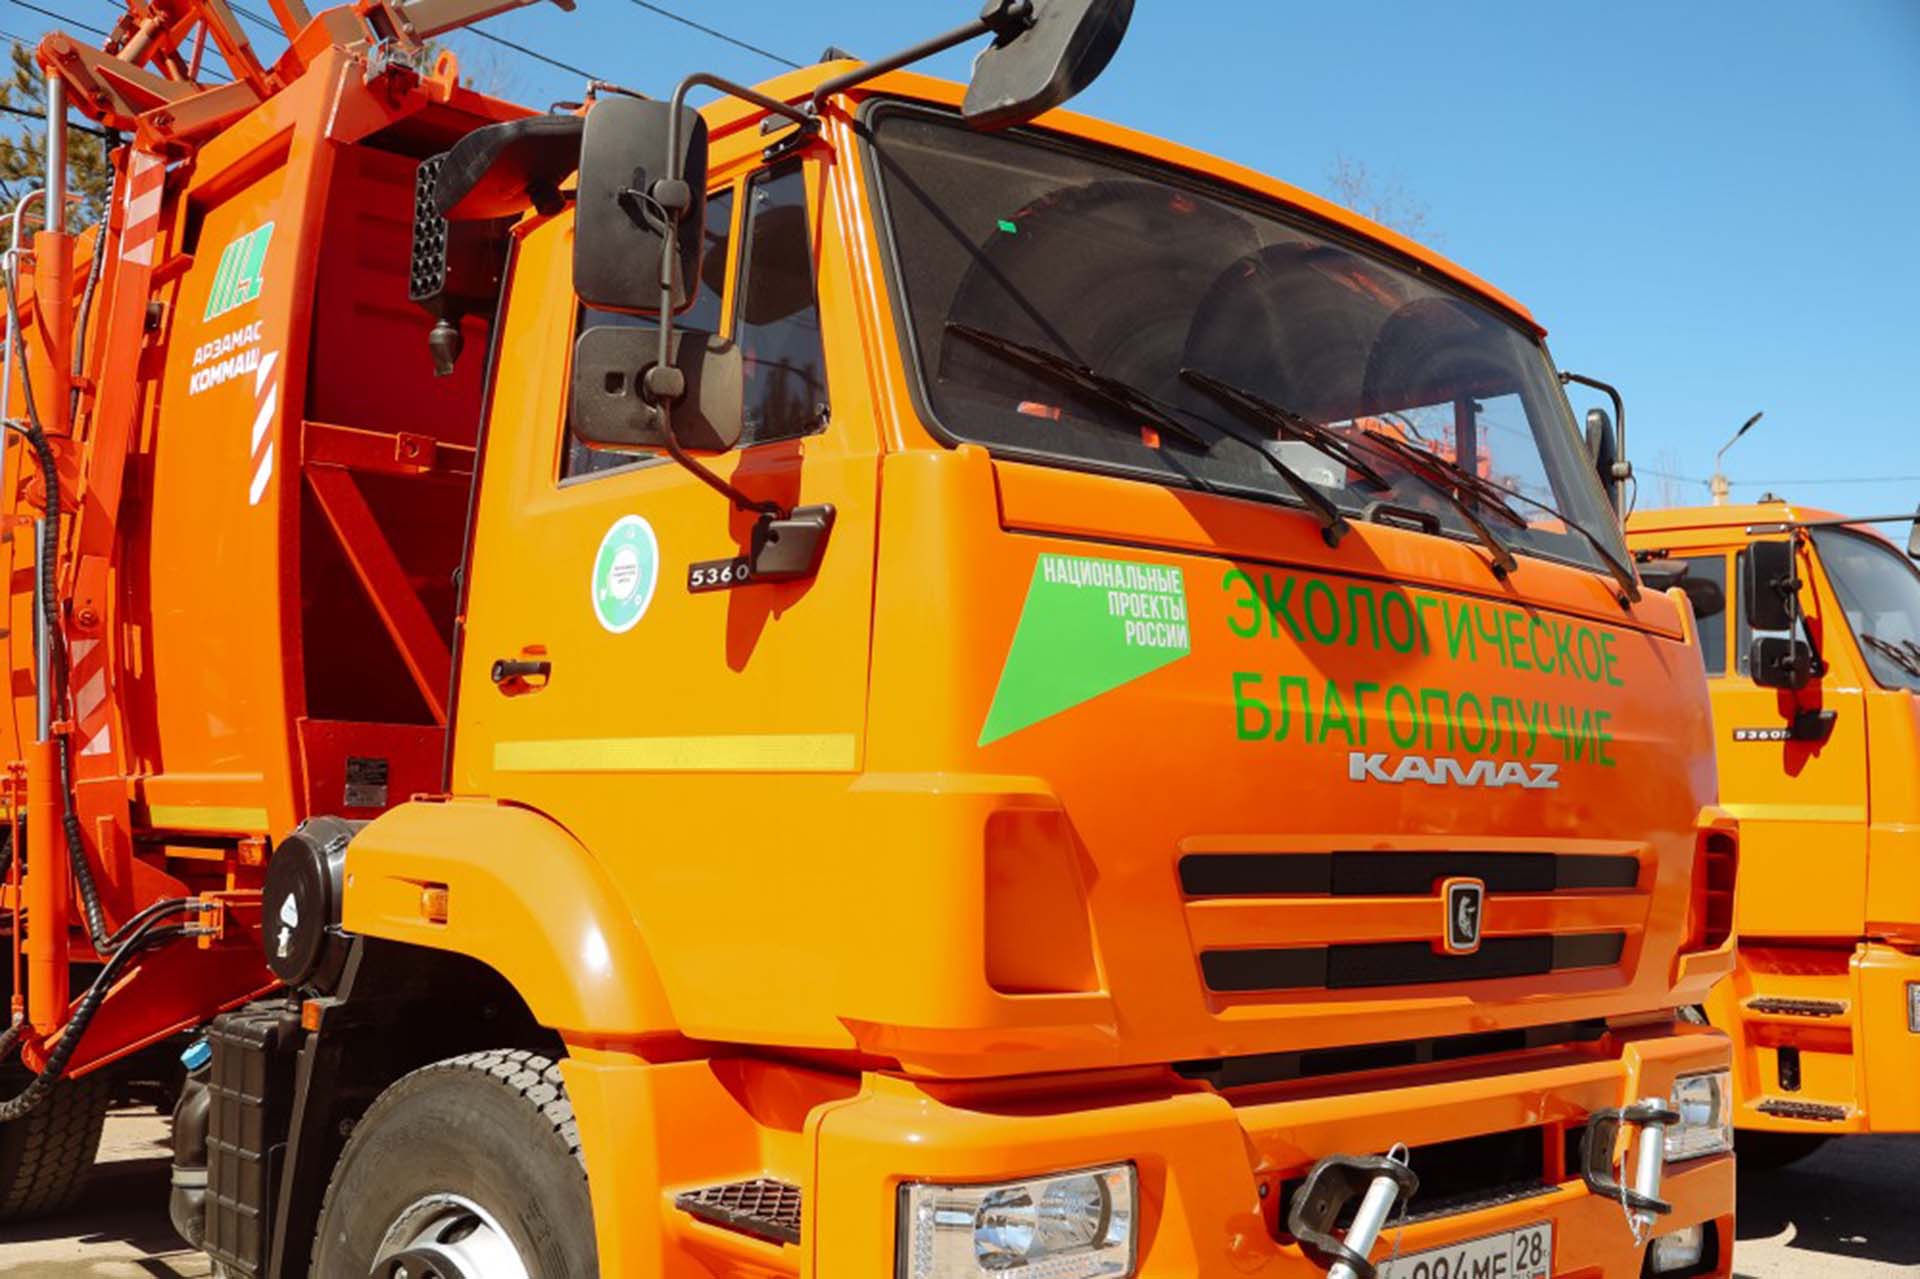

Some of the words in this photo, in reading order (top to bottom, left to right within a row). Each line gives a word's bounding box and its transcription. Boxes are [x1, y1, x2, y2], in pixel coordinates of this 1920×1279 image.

[193, 321, 263, 366] АРЗАМАС
[190, 348, 260, 395] КОММАШ
[691, 564, 750, 586] 5360
[1043, 557, 1182, 594] НАЦИОНАЛЬНЫЕ
[1108, 591, 1186, 621] ПРОЕКТЫ
[1125, 620, 1188, 649] РОССИИ
[1222, 568, 1625, 687] ЭКОЛОГИЧЕСКОЕ
[1232, 672, 1617, 766] БЛАГОПОЛУЧИЕ
[1349, 752, 1559, 789] KAMAZ
[1402, 1252, 1507, 1279] 94МЕ
[1516, 1231, 1542, 1270] 28
